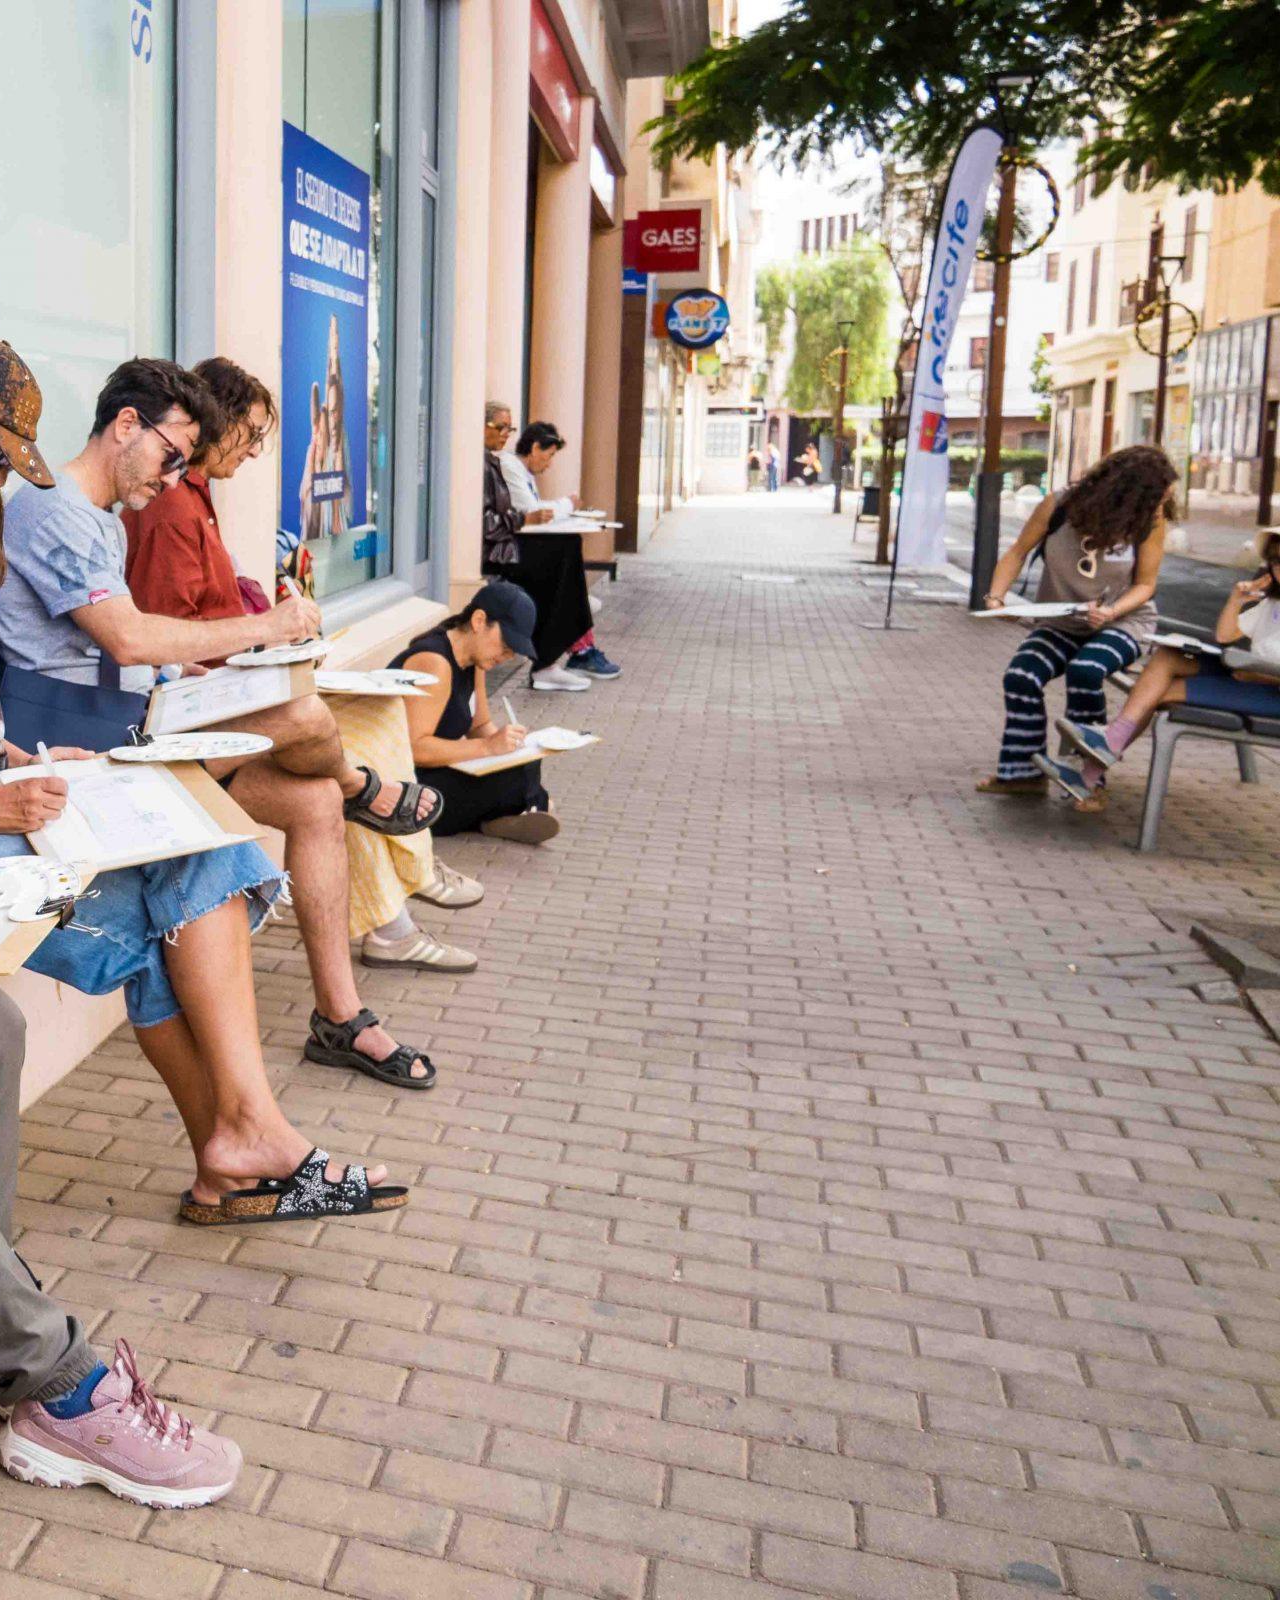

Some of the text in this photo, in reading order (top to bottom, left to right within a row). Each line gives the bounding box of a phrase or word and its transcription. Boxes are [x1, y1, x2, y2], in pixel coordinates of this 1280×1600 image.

[289, 219, 309, 260] QUE
[309, 227, 321, 264] SE
[321, 232, 350, 274] ADAPTA
[641, 228, 697, 247] GAES
